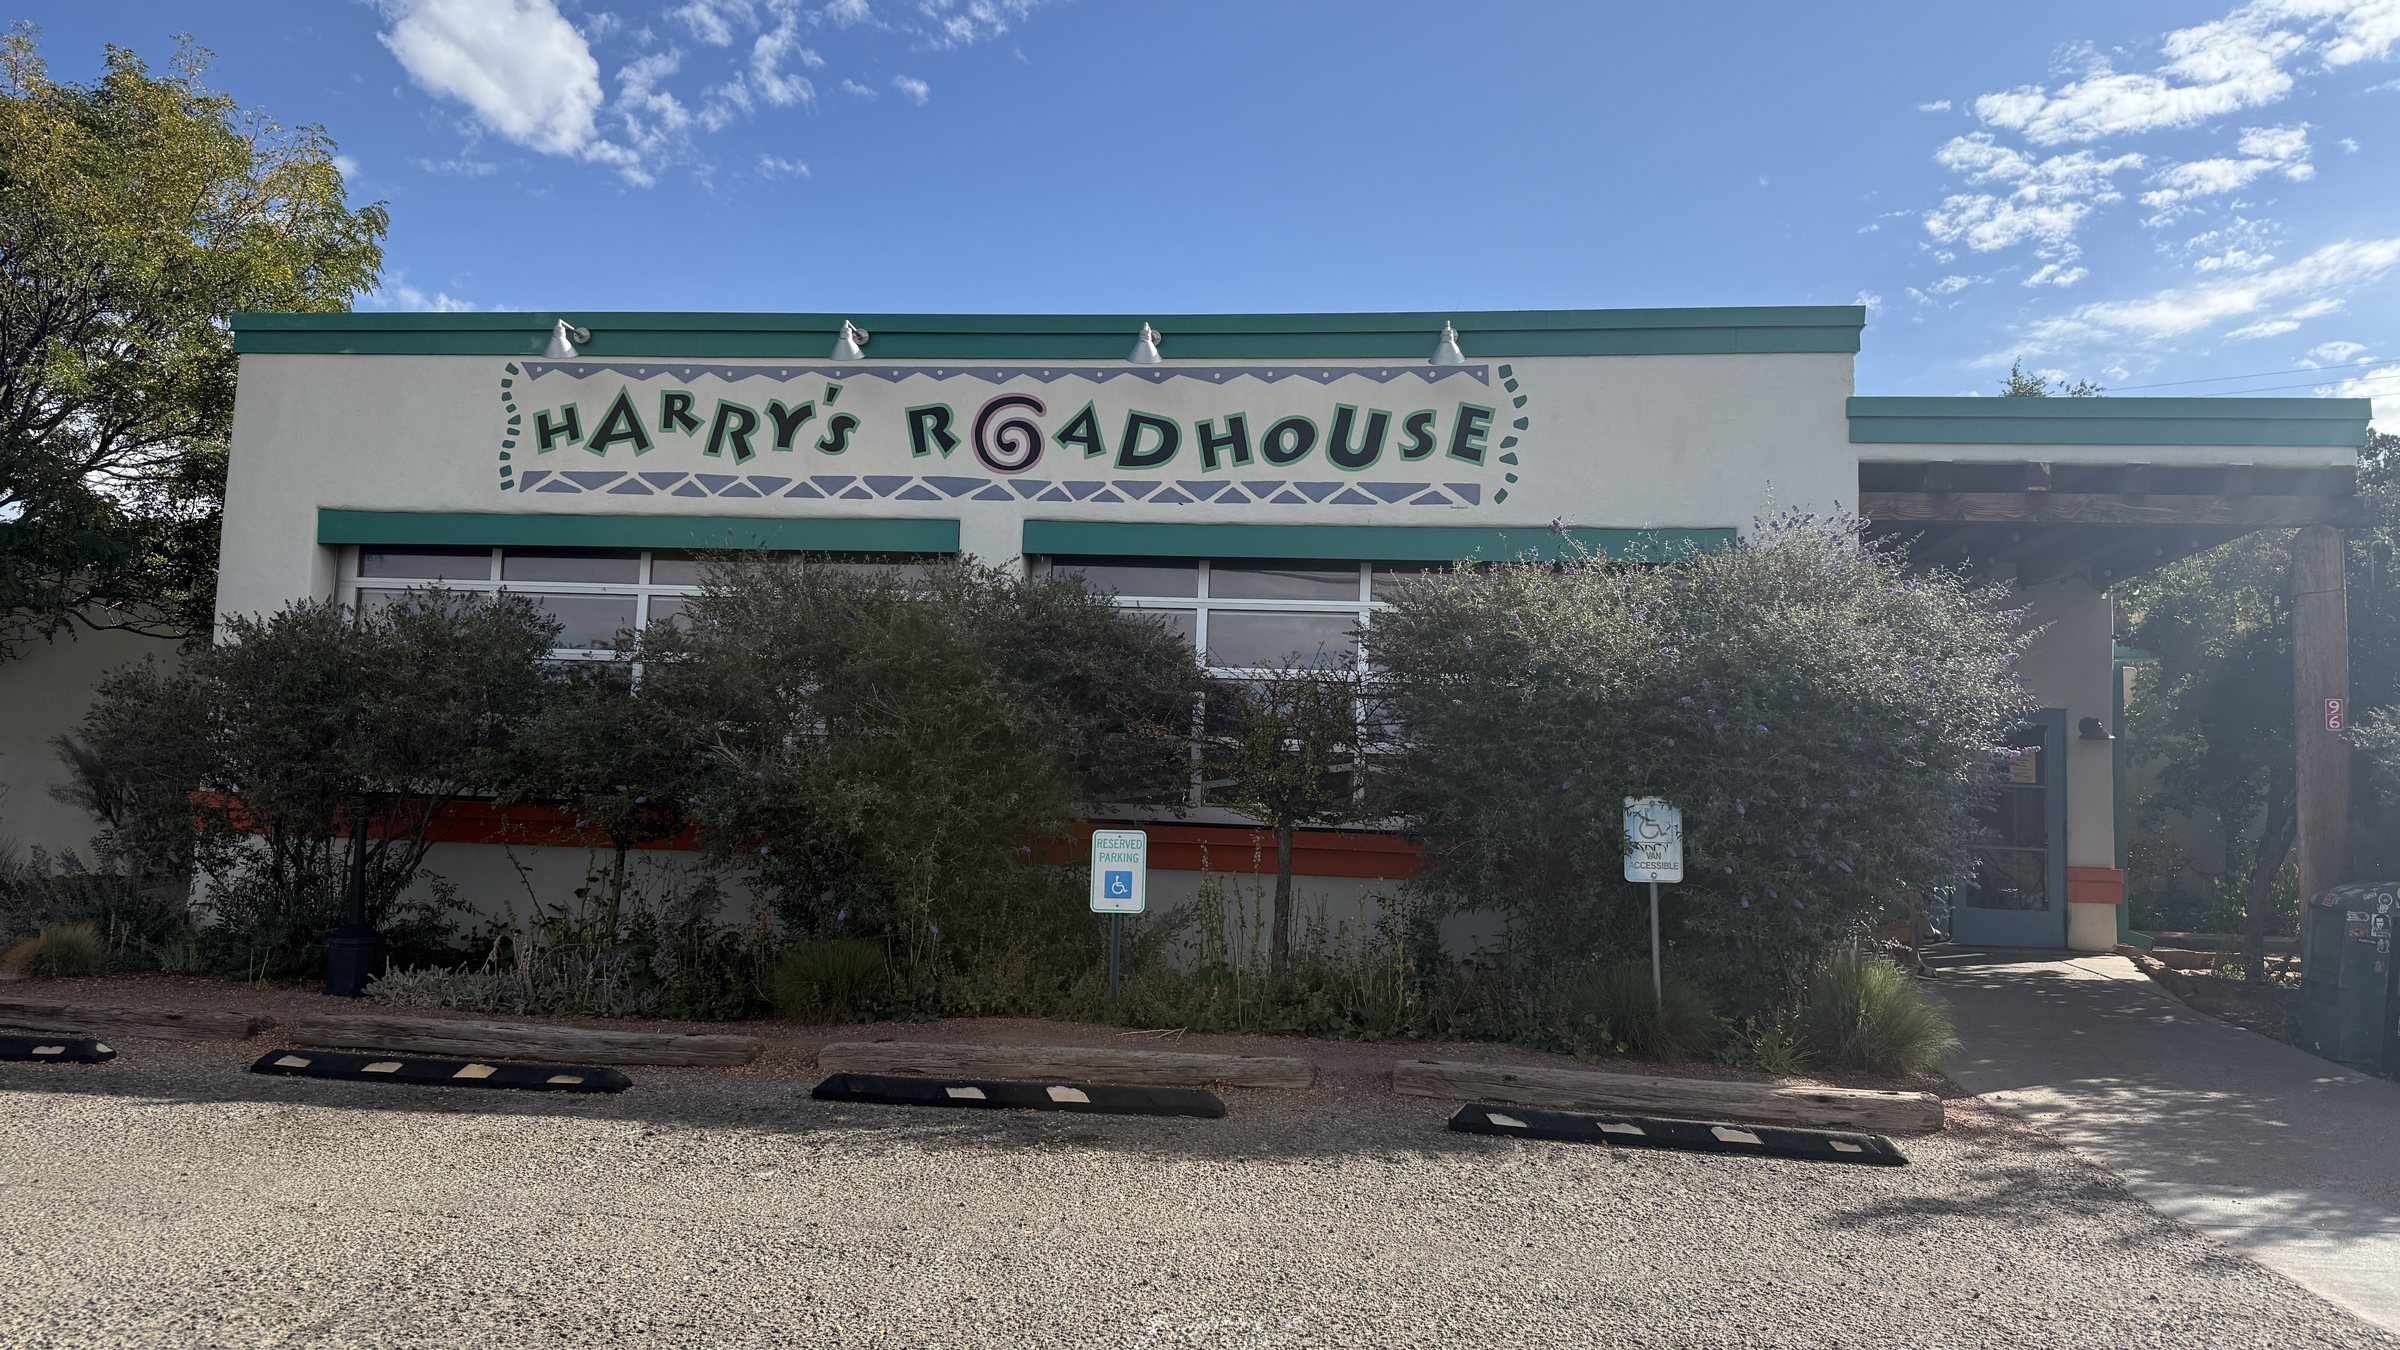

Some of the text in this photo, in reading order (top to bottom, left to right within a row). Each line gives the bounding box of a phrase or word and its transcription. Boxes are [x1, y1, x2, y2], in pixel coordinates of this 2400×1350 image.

[532, 383, 1496, 475] HARRY'S ROADHOUSE
[2328, 700, 2340, 729] 96
[1096, 838, 1143, 850] RESERVED
[1099, 852, 1139, 863] PARKING
[1645, 851, 1662, 860] VAN
[1630, 861, 1680, 870] ACCESSIBLE
